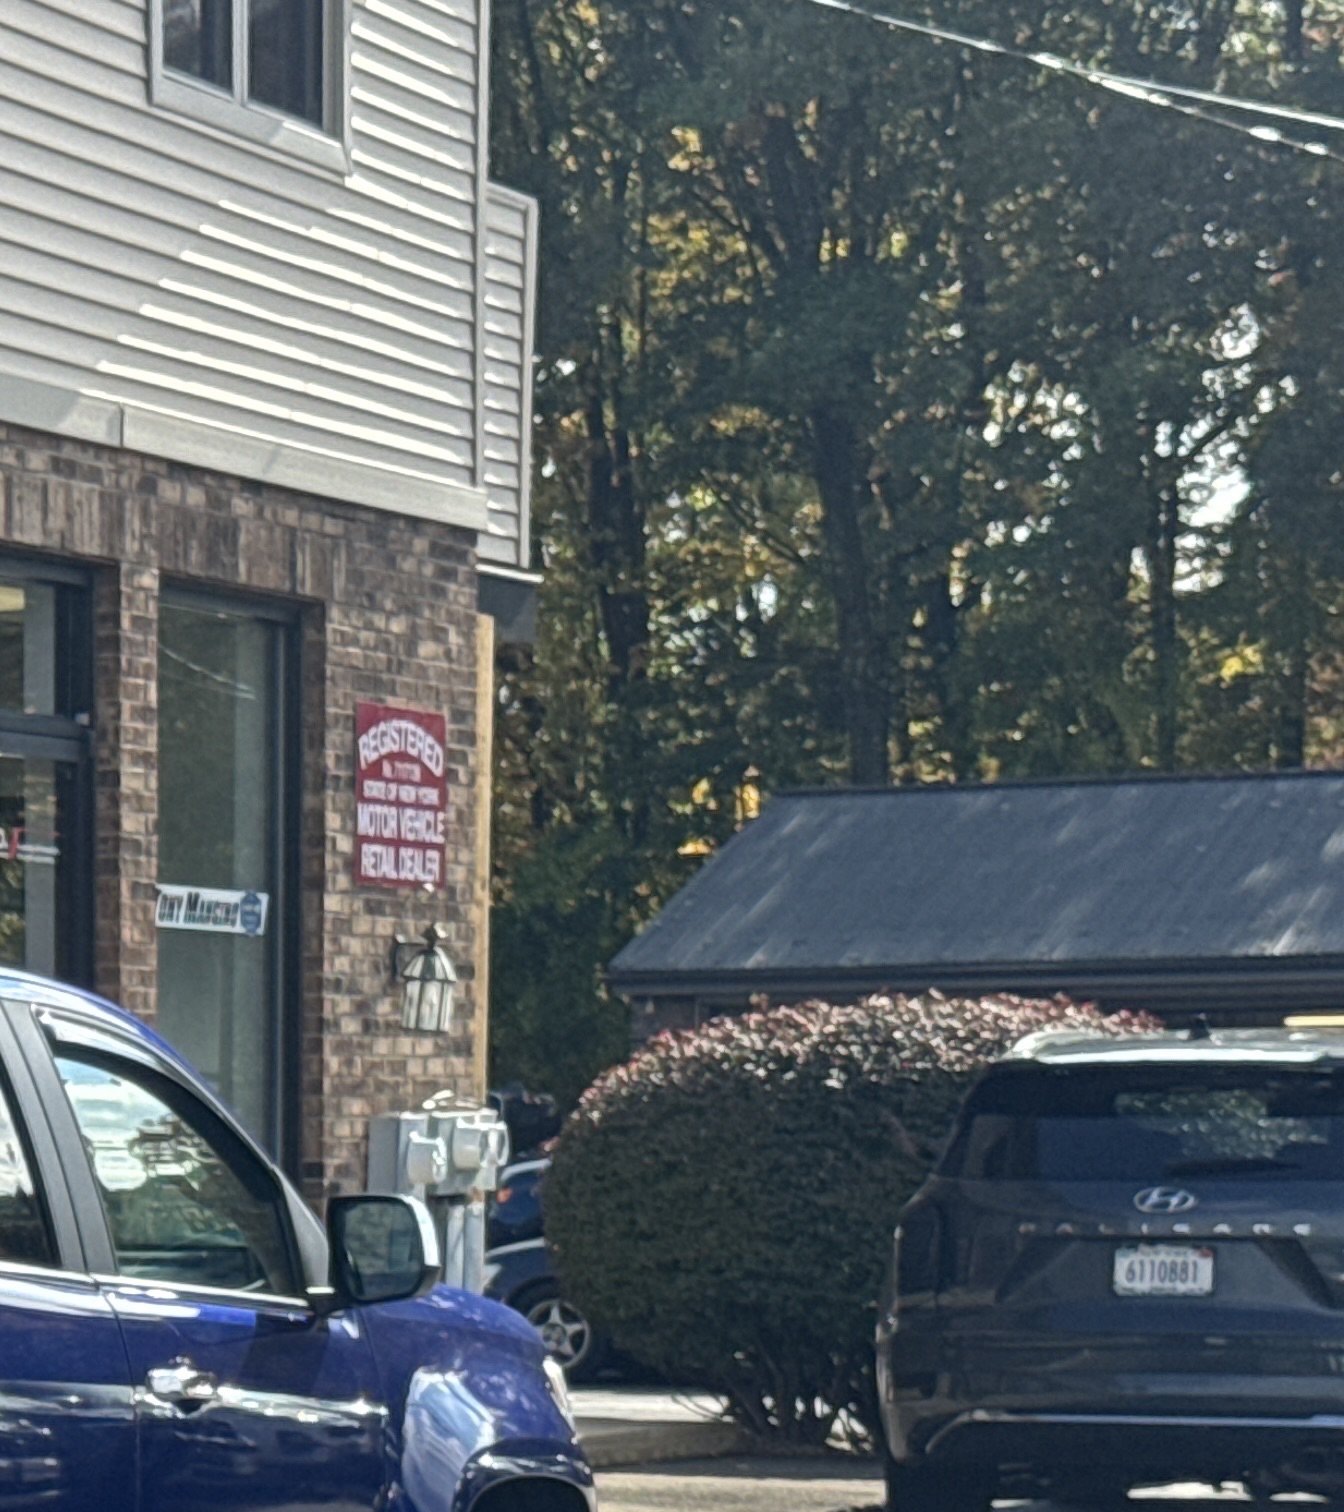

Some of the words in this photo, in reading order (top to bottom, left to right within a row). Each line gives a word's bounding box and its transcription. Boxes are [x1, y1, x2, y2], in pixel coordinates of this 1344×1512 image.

[358, 719, 444, 777] REGISTERED
[357, 802, 398, 840] MOTOR
[399, 807, 445, 844] VEHICLE
[361, 843, 398, 880] RETAIL
[399, 846, 440, 882] DEALER
[158, 894, 183, 923] ONY
